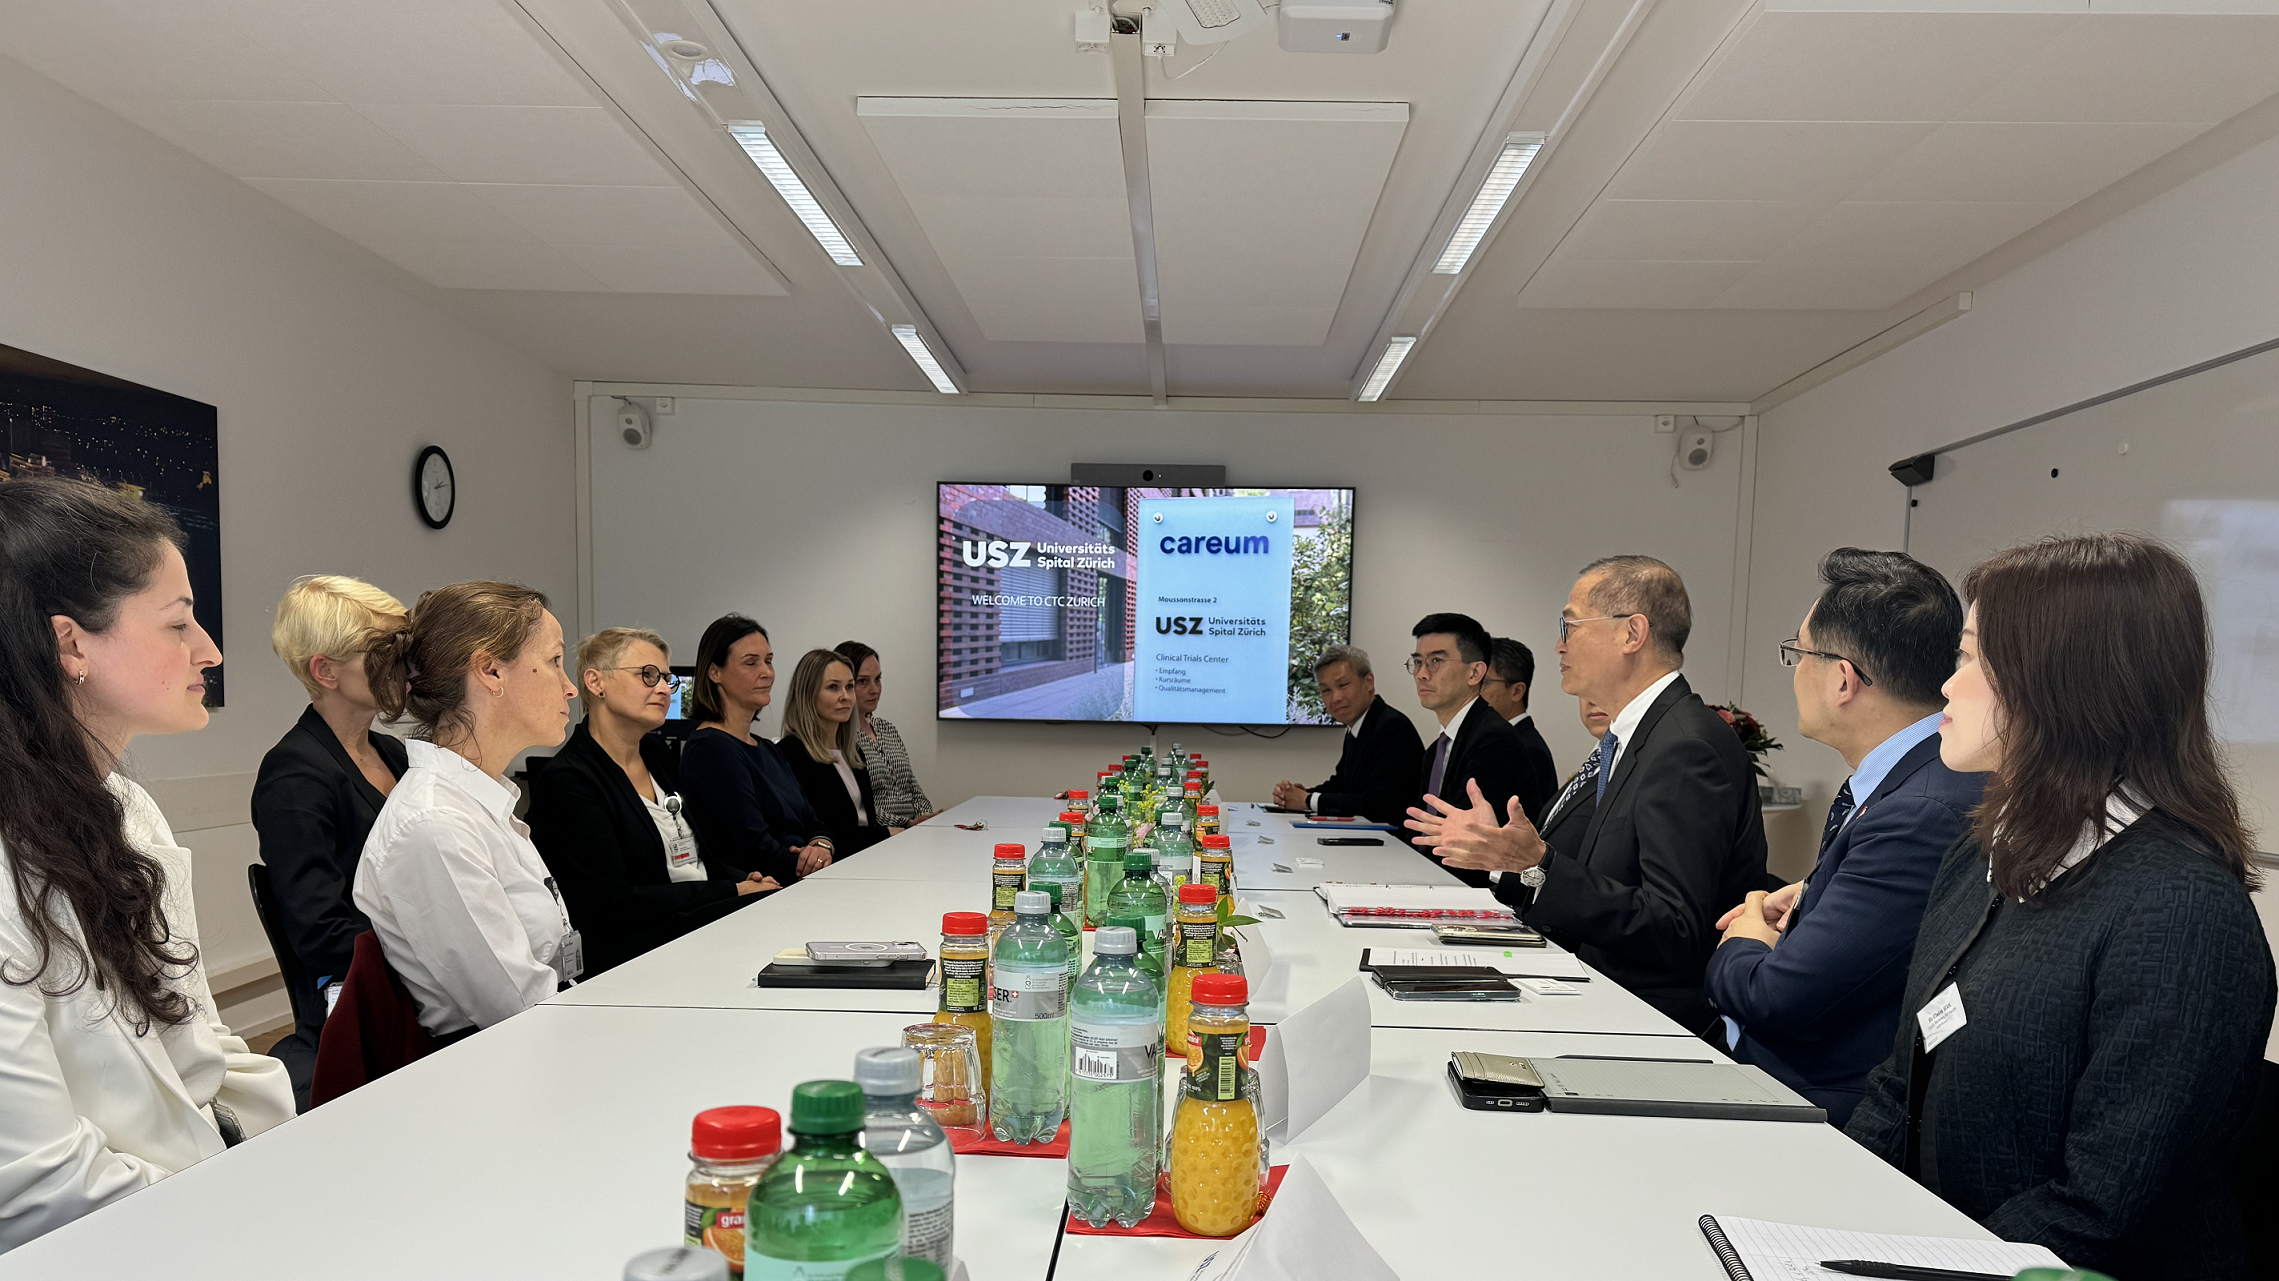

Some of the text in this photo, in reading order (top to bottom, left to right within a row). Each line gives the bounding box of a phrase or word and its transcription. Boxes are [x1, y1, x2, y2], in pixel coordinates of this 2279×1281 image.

[1037, 542, 1116, 555] Universitäts
[1159, 535, 1270, 555] careum
[962, 540, 1032, 568] USZ
[1037, 556, 1116, 570] Spital Zürich
[972, 594, 1106, 608] WELCOME TO CTC ZURICH
[1155, 616, 1204, 635] USZ
[1208, 616, 1267, 626] Universitäts
[1208, 627, 1267, 637] Spital Zürich
[1155, 653, 1229, 664] Clinical Trials Center
[1158, 668, 1186, 676] Empfang
[1158, 676, 1191, 684] Kursräume
[1158, 685, 1226, 695] Qualitätsmanagement
[1034, 1012, 1055, 1020] 500ml
[720, 1215, 745, 1229] gra
